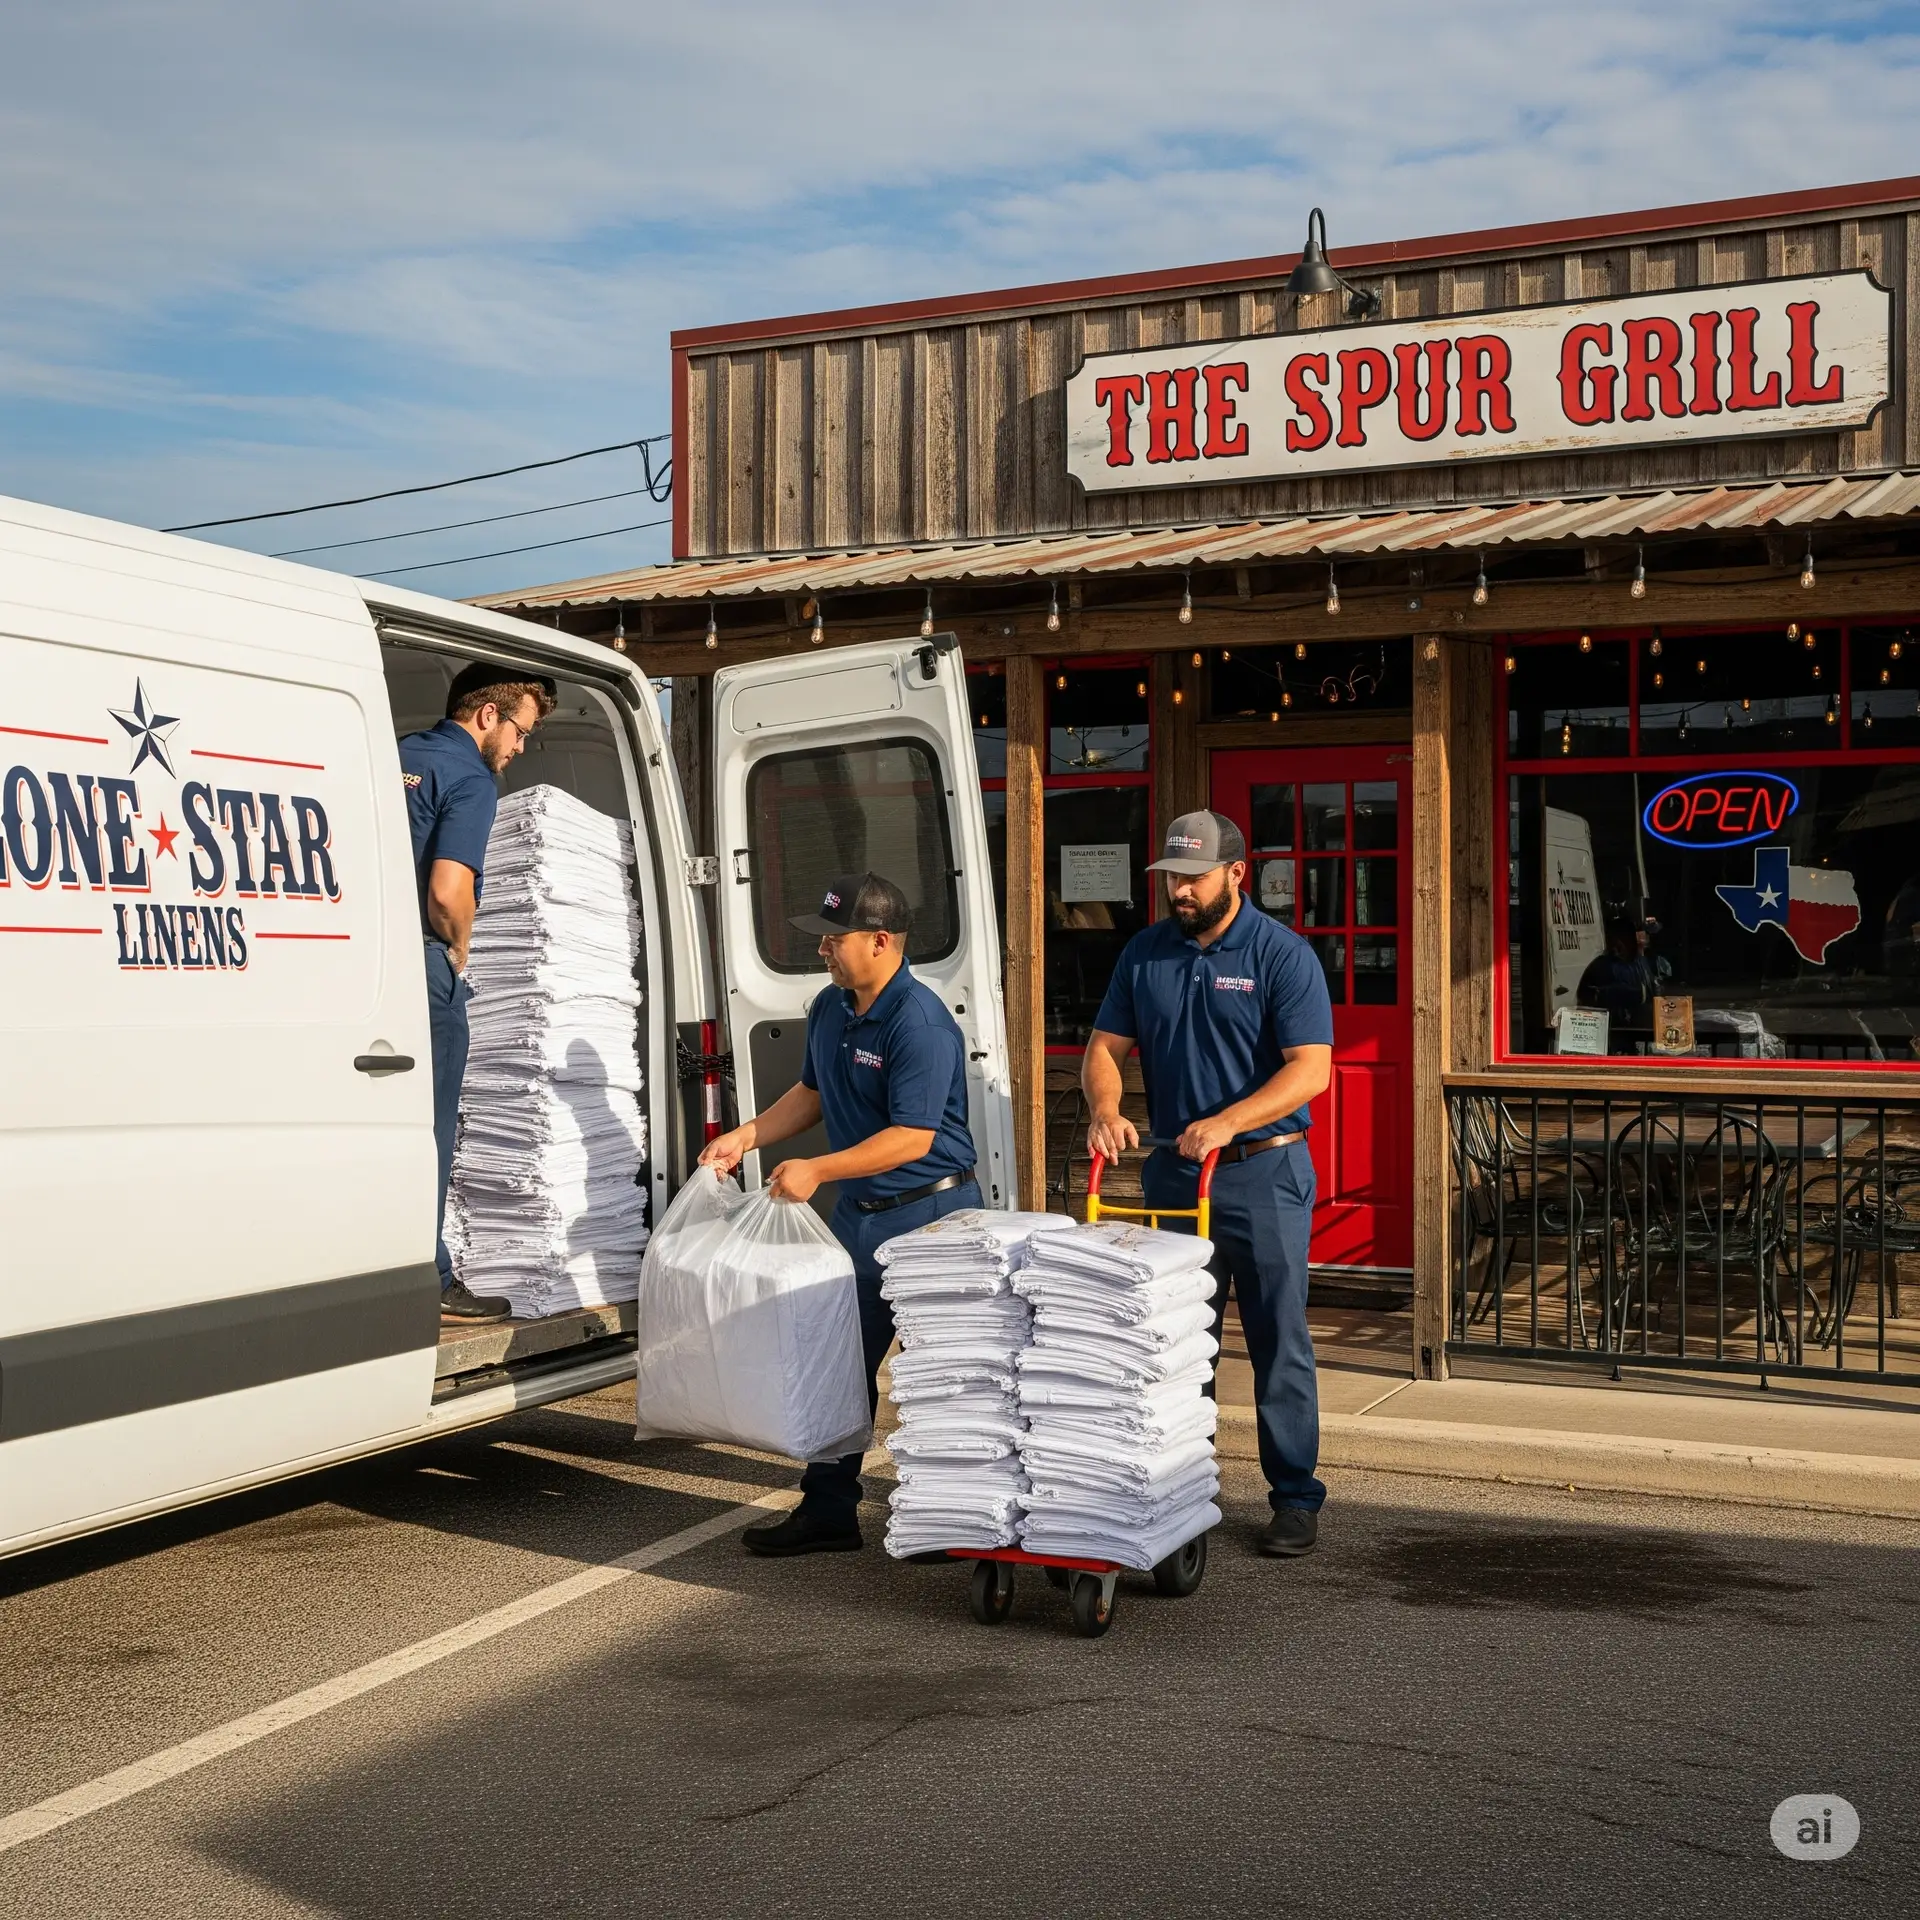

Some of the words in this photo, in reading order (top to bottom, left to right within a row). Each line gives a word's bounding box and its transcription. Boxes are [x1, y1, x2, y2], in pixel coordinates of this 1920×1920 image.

[1095, 361, 1249, 468] THE
[1284, 334, 1517, 453] SPUR
[1556, 300, 1844, 427] GRILL
[0, 765, 151, 893] ONE
[181, 781, 342, 903] STAR
[1652, 787, 1790, 833] OPEN
[113, 903, 249, 970] LINENS
